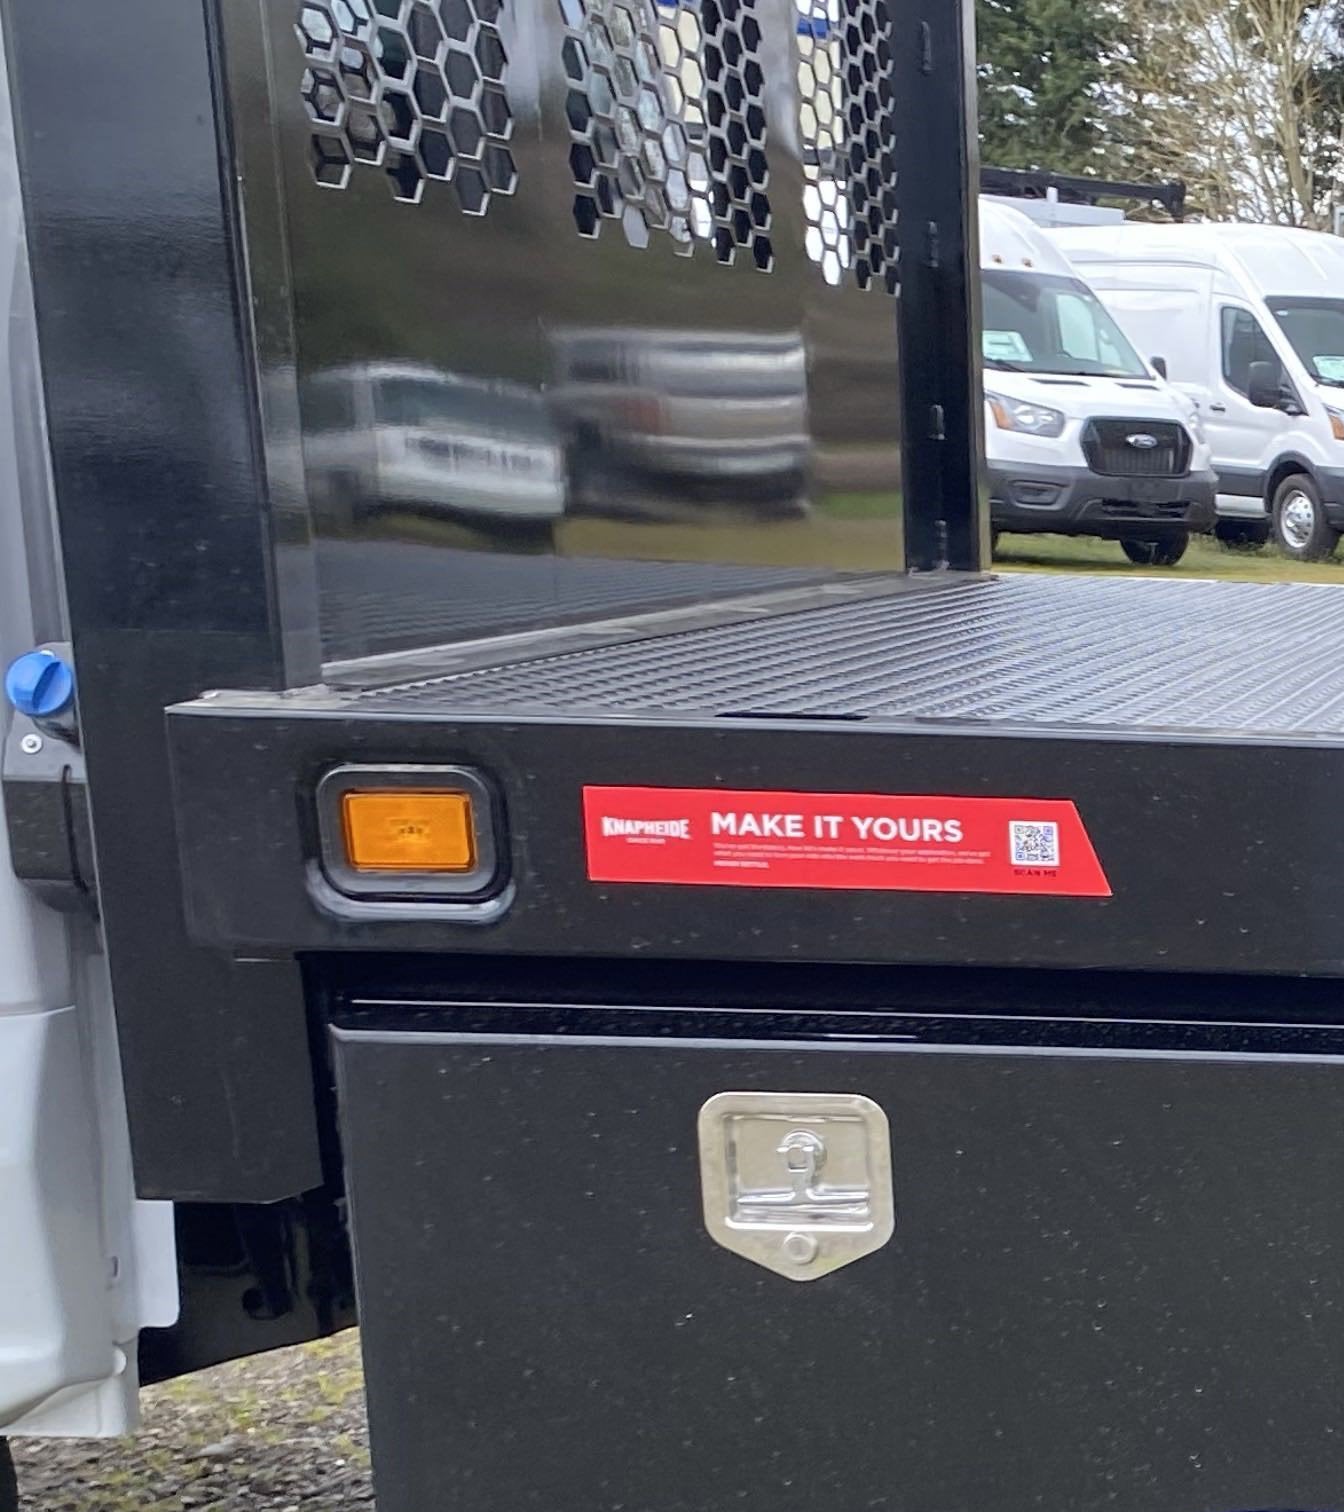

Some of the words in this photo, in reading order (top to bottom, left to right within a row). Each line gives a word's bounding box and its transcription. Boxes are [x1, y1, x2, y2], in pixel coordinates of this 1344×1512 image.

[601, 815, 693, 839] KNAPHEIDE
[711, 812, 805, 838] MAKE
[814, 815, 843, 839] IT
[851, 817, 963, 842] YOURS
